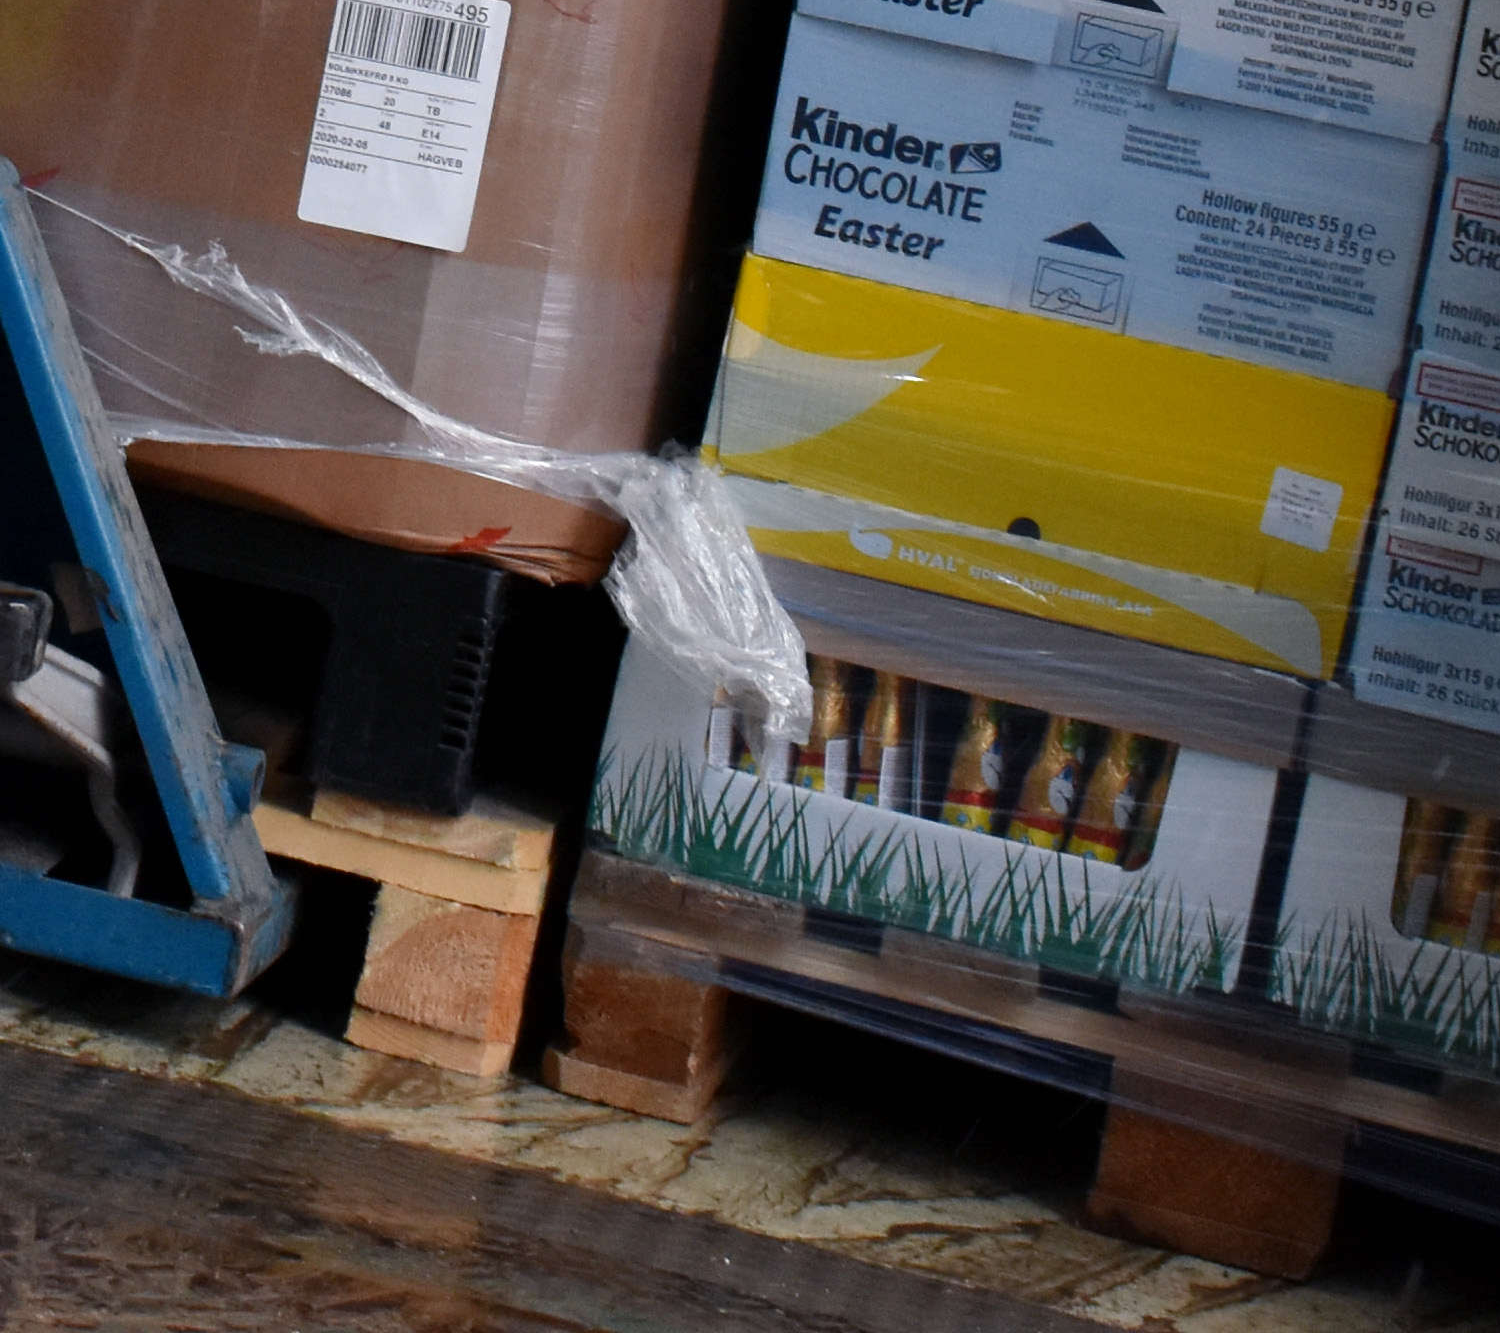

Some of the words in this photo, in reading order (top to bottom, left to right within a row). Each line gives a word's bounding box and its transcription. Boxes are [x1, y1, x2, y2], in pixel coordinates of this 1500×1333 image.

[453, 4, 490, 25] 495
[1399, 0, 1413, 19] g
[382, 96, 397, 108] 20
[426, 105, 442, 117] TB
[318, 107, 327, 117] 2
[378, 120, 392, 132] 48
[420, 129, 441, 142] E14
[417, 151, 464, 170] HAGVEB
[783, 142, 988, 224] CHOCOLATE
[1201, 189, 1259, 216] Hollow
[1260, 201, 1315, 229] figures
[1317, 214, 1341, 234] 55
[1341, 221, 1354, 241] g
[813, 202, 946, 261] Easter
[1174, 204, 1243, 234] Content:
[1244, 218, 1266, 238] 24
[1269, 223, 1321, 251] Pieces
[1323, 235, 1335, 254] à
[1337, 239, 1360, 259] 55
[1361, 246, 1374, 265] g
[1434, 322, 1489, 348] Inhalt:
[1402, 483, 1474, 515] Hohlfigur
[1399, 507, 1454, 533] Inhalt:
[1456, 520, 1481, 540] 26
[897, 544, 957, 573] HVAL
[1371, 644, 1442, 677] Hohlfigur
[1443, 661, 1483, 686] 3x15
[1483, 674, 1495, 691] g
[1424, 682, 1449, 702] 26
[1452, 689, 1500, 714] Stück
